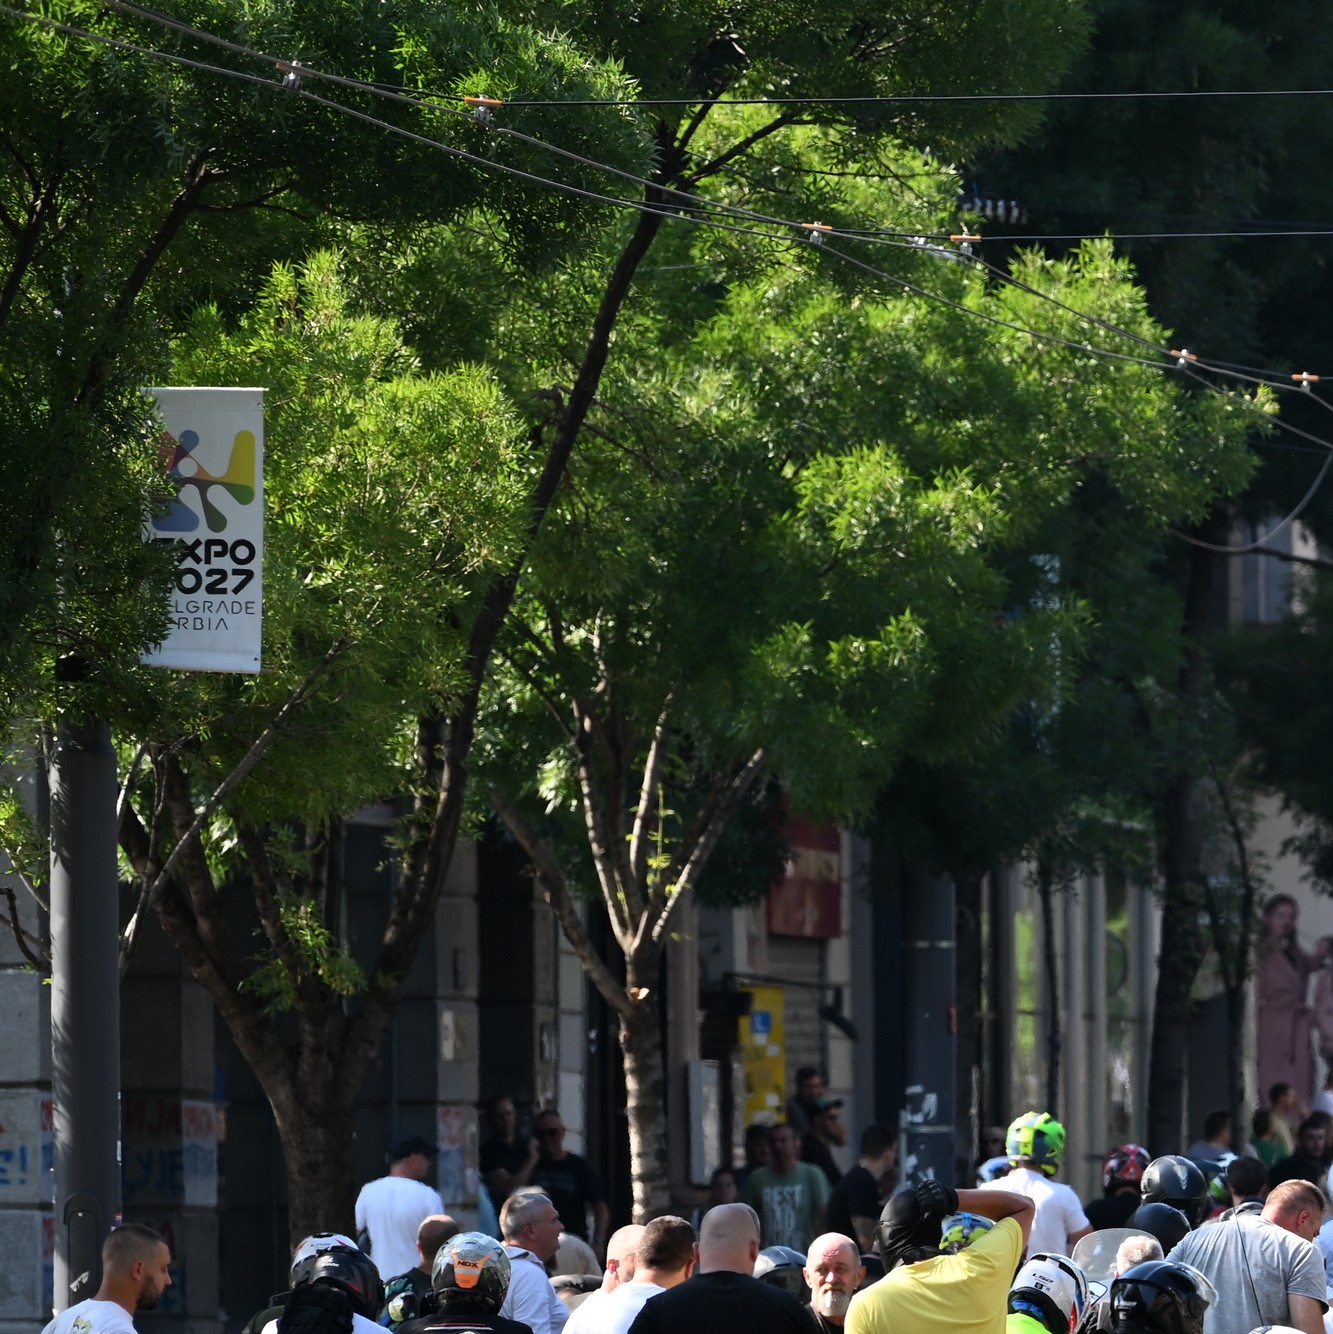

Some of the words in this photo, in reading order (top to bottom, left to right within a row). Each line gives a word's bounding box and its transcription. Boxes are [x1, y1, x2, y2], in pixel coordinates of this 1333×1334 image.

[151, 538, 255, 565] XPO
[168, 567, 255, 595] 027
[175, 600, 256, 615] LGRADE
[177, 617, 229, 630] RBIA
